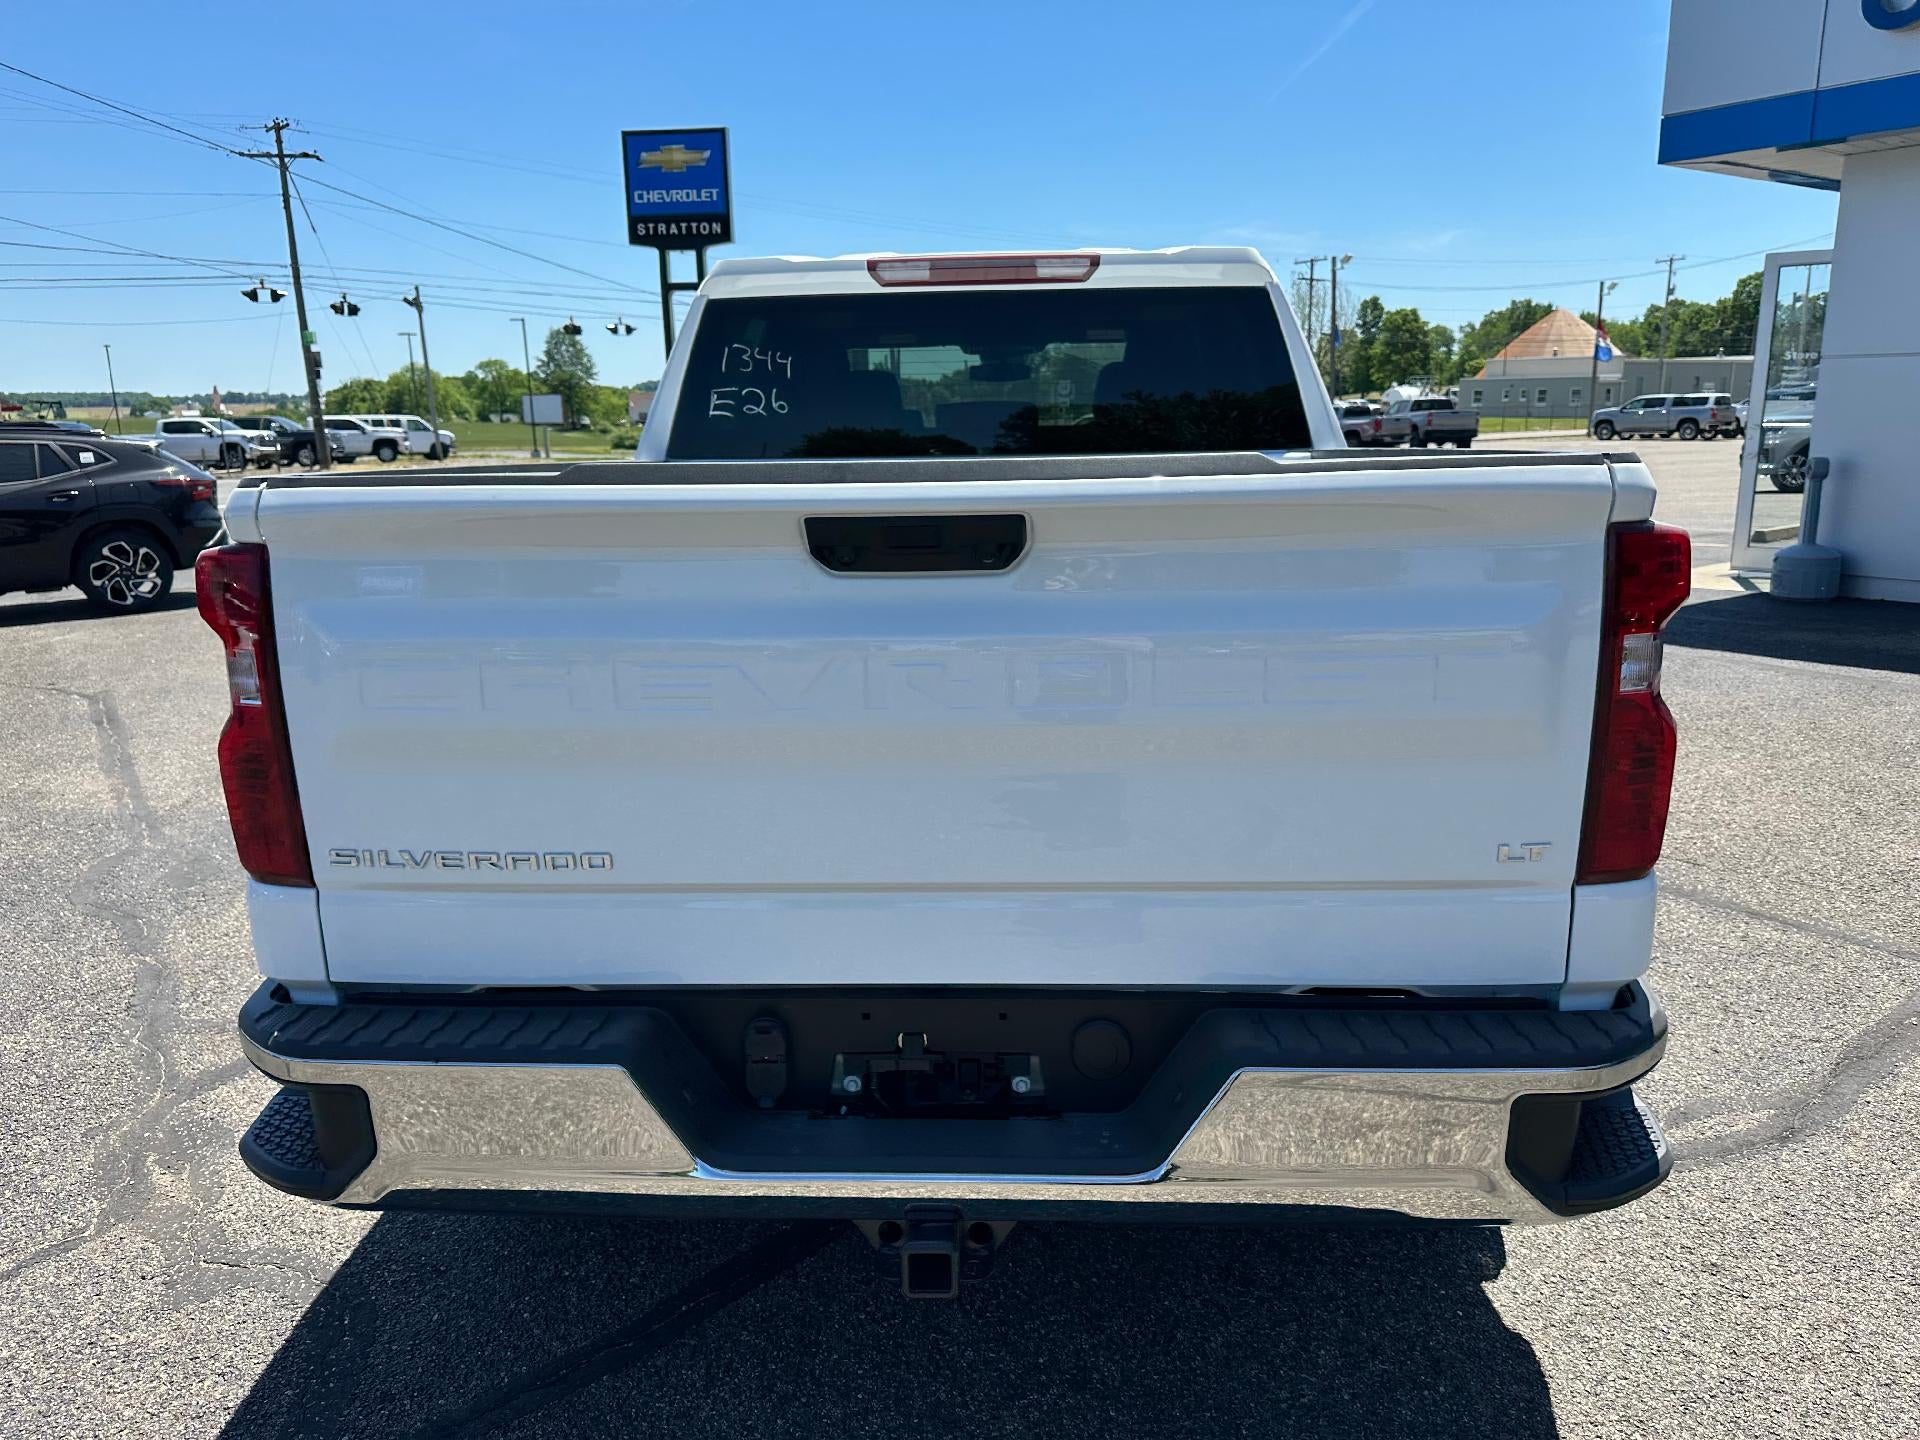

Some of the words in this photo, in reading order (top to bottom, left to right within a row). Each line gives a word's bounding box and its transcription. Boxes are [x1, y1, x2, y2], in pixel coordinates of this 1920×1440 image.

[634, 188, 719, 204] CHEVROLET
[637, 222, 722, 235] STRATTON
[721, 343, 792, 379] 1344
[709, 387, 789, 417] E26
[356, 653, 1496, 711] CHEVROLET
[328, 848, 614, 871] SILVERADO
[1496, 841, 1552, 863] LT
